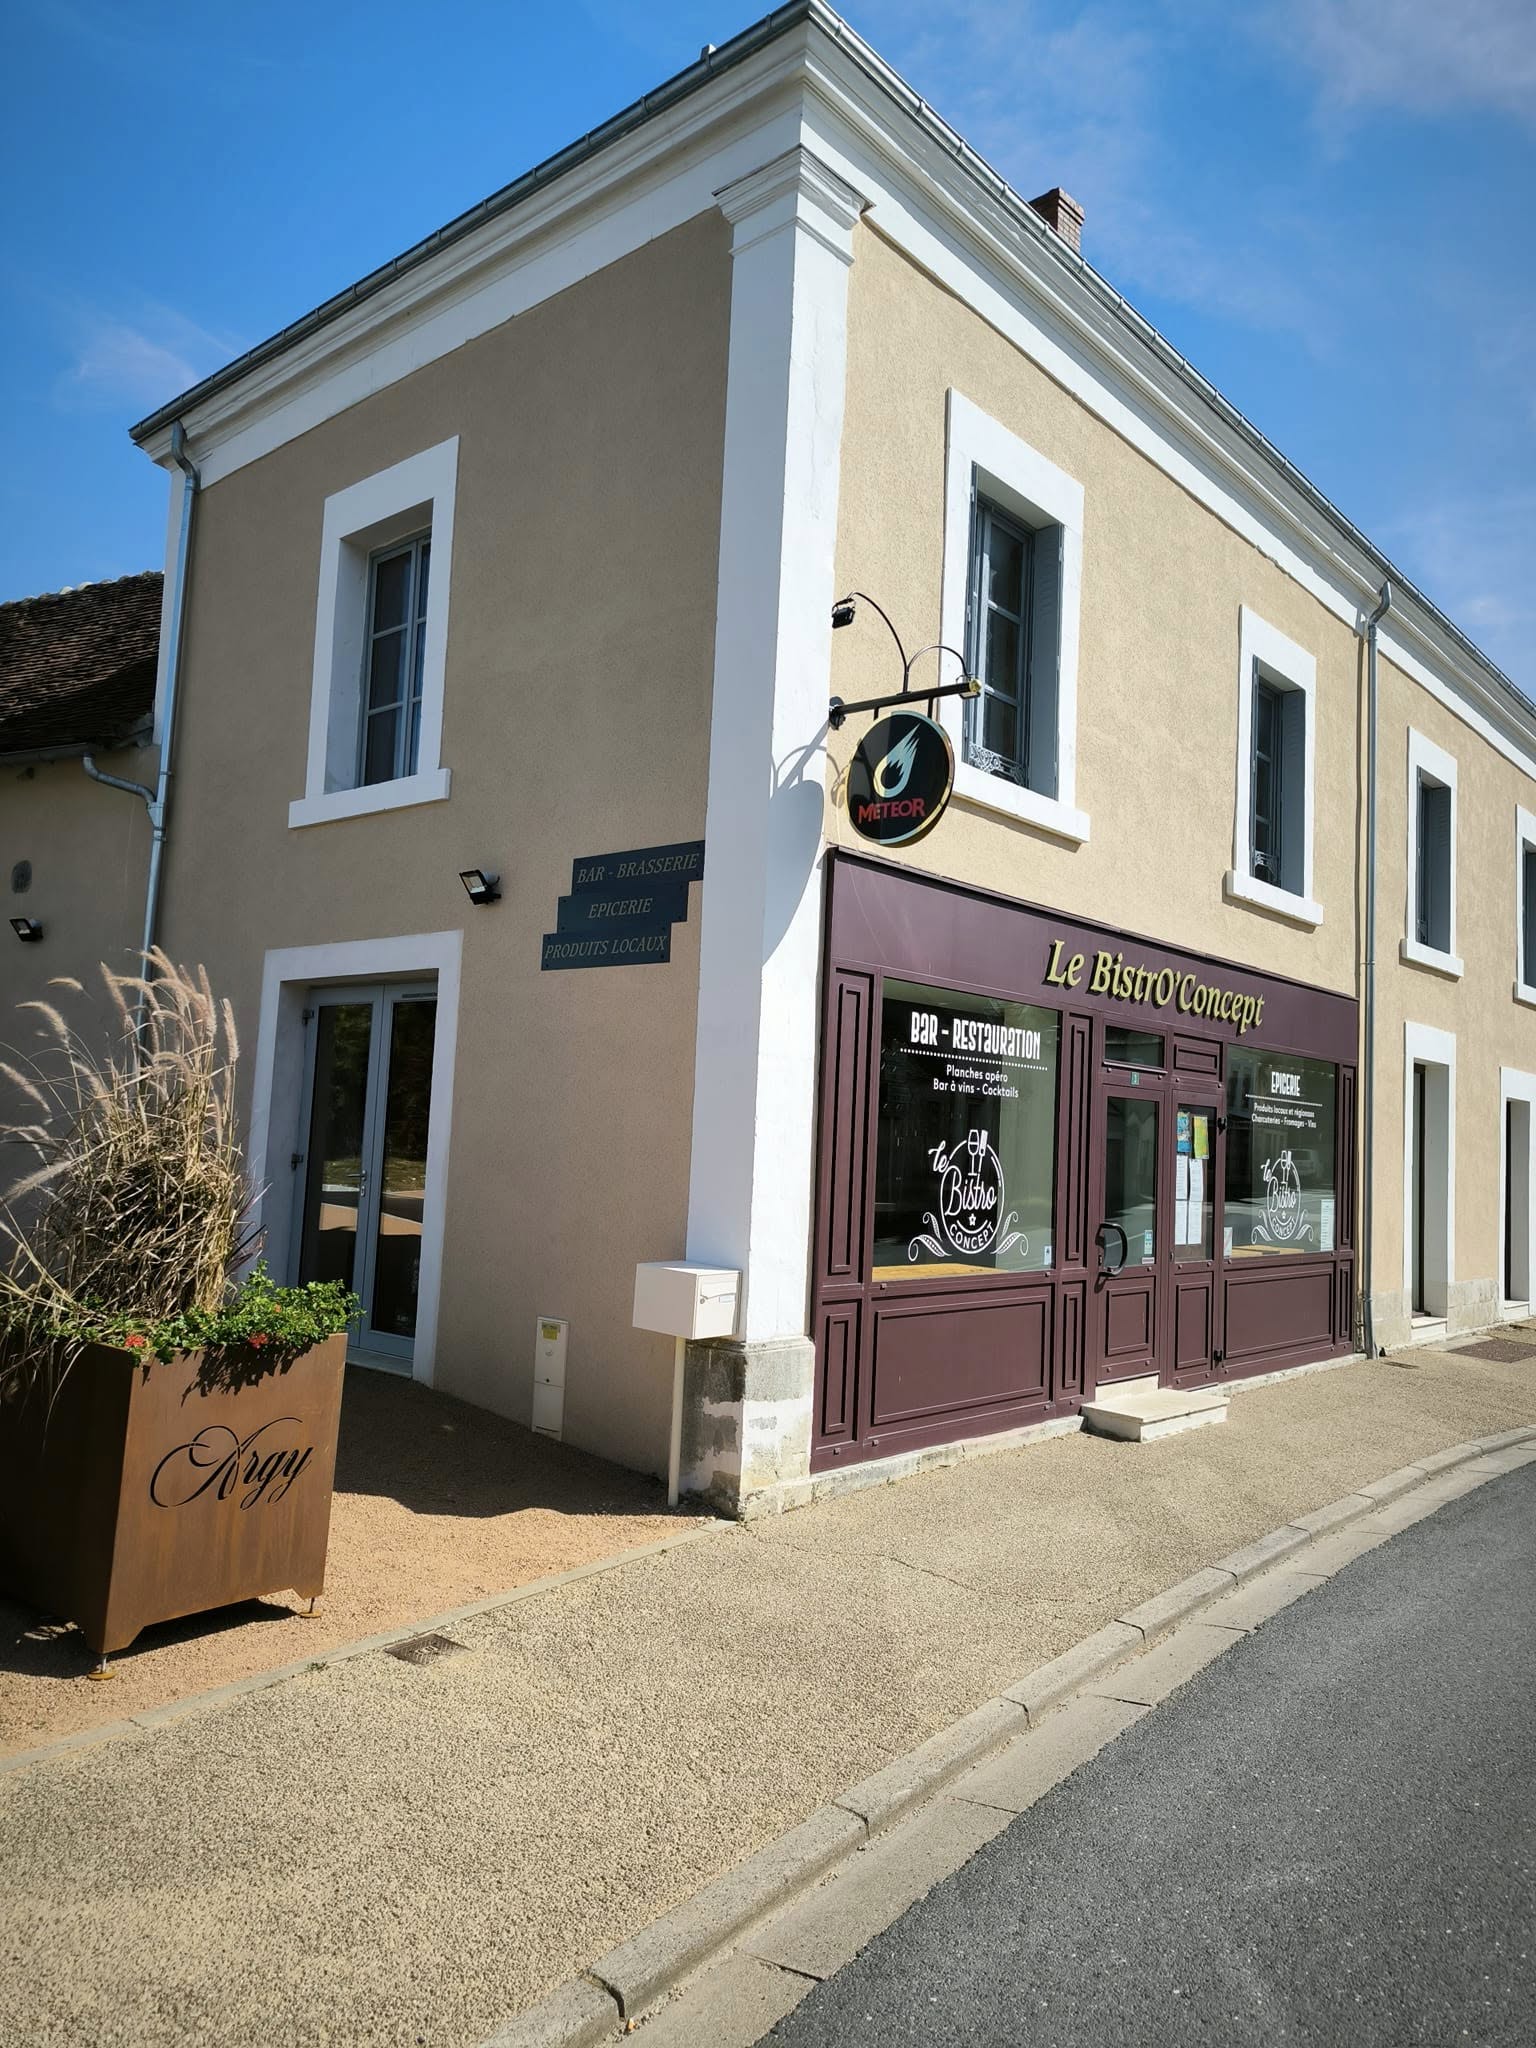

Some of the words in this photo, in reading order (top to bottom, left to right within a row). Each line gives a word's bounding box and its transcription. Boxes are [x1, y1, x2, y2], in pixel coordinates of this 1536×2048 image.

[858, 797, 926, 824] METEOR
[577, 866, 605, 883] BAR
[616, 853, 700, 879] BRASSERIE
[588, 898, 653, 919] EPICERIE
[544, 940, 608, 960] PRODUITS
[611, 935, 668, 954] LOCAUX
[1046, 939, 1086, 987] Le
[946, 1064, 983, 1080] Planches
[985, 1069, 1008, 1083] apéro
[1271, 1071, 1300, 1097] EPICERIE
[933, 1077, 949, 1091] Bar
[950, 1080, 956, 1092] à
[958, 1082, 975, 1094] vins
[982, 1083, 1019, 1098] Cocktails
[943, 1165, 998, 1216] Bistro
[949, 1220, 994, 1250] CONCEPT
